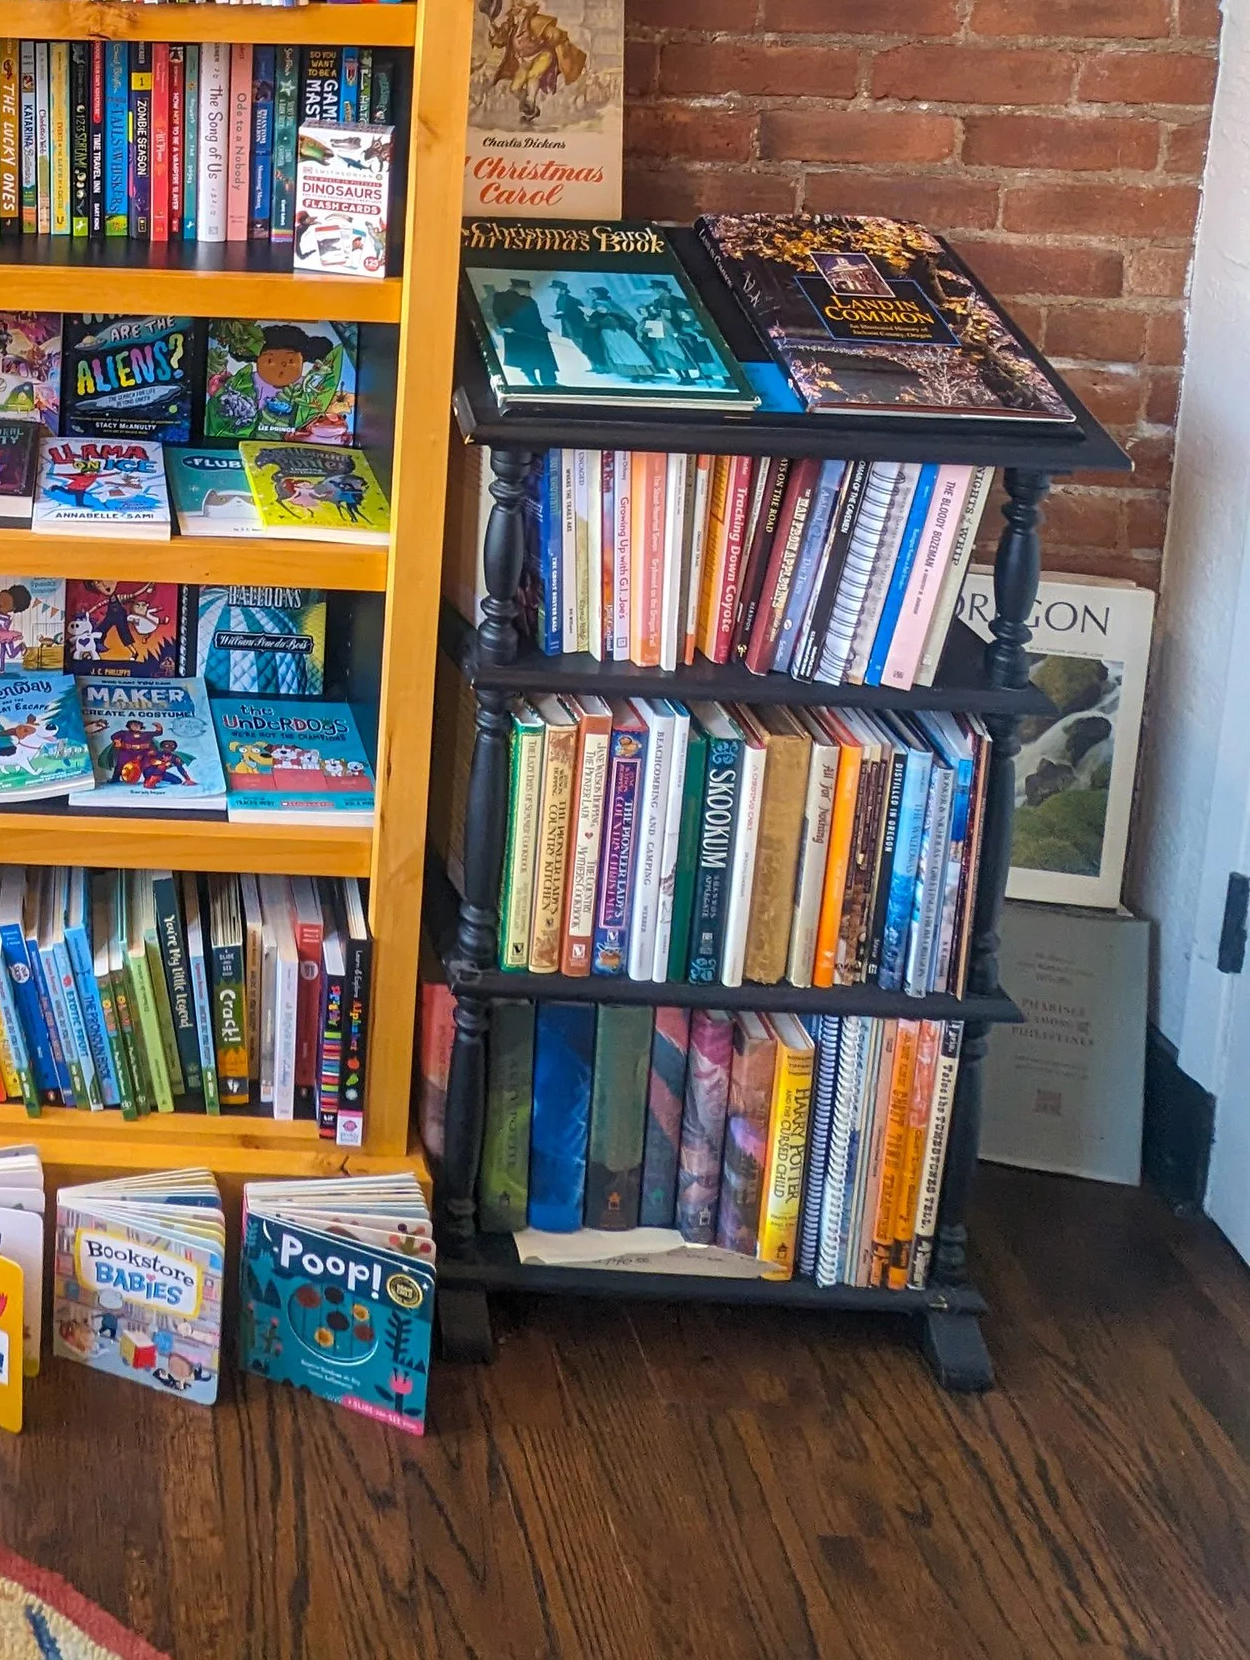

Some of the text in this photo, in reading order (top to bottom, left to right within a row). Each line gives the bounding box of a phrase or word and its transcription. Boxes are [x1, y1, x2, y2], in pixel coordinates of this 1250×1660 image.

[237, 93, 246, 118] Ode
[24, 104, 34, 147] KATARINA
[205, 112, 223, 142] Song
[237, 121, 245, 132] to
[1, 83, 15, 211] THE LUCKY ONES
[137, 138, 147, 175] SEASON
[210, 147, 223, 159] of
[524, 138, 566, 149] Dickens
[93, 133, 101, 193] TIME TRAVEL INN
[209, 164, 223, 179] Us
[234, 146, 246, 190] Nobody
[474, 156, 604, 183] Christmas
[302, 183, 382, 200] DINOSAURS
[480, 182, 562, 205] Carol
[305, 200, 377, 215] FLASH CARDS
[465, 232, 665, 253] hristmas Book
[471, 221, 652, 241] Christmas Carol
[825, 306, 934, 324] COMMON
[830, 296, 919, 312] LAND IN
[110, 316, 176, 343] ARE THE
[77, 334, 185, 395] ALIENS?
[95, 422, 157, 431] STACY McANULTY
[48, 443, 148, 463] LLAMA
[72, 458, 157, 474] ON ICE
[55, 511, 154, 520] ANNABELLE SAMI
[618, 497, 635, 537] Growing
[925, 481, 956, 568] THE BLOODY BOZEMAN
[619, 540, 633, 554] Up
[721, 487, 747, 632] Tracking Down Coyote
[229, 585, 301, 608] BALLOONS
[619, 578, 627, 595] G.I.
[619, 598, 627, 619] Joe's
[87, 686, 186, 703] MAKER
[644, 732, 664, 886] BEACHCOMBING AND CAMPING
[702, 769, 736, 868] SKOOKUM
[885, 764, 902, 852] DISTILLED IN OREGON
[164, 915, 193, 1028] You're My Little Legend
[220, 989, 241, 1042] Crack!
[785, 1088, 813, 1203] HARRY POTTER
[85, 1239, 194, 1288] Bookstore
[278, 1232, 383, 1299] Poop!
[96, 1262, 182, 1305] BABIES
